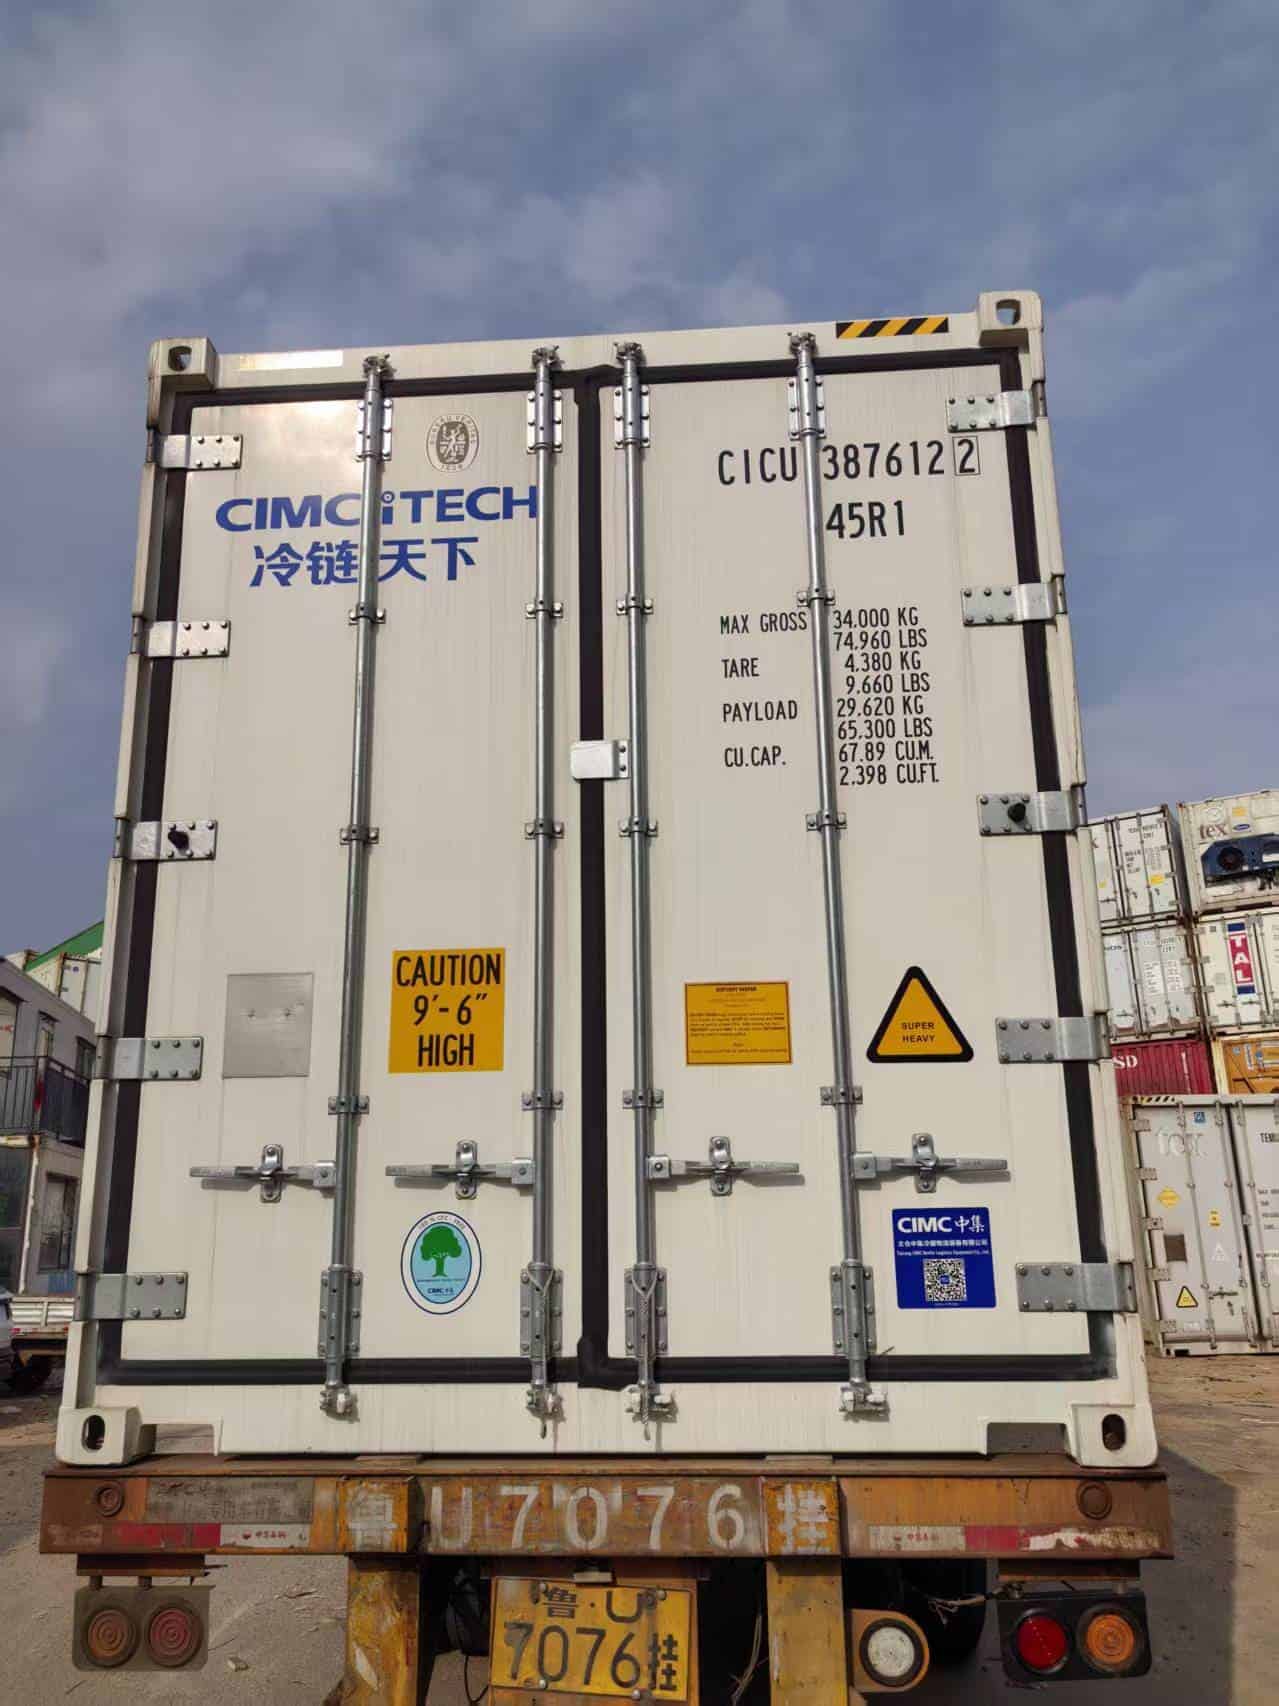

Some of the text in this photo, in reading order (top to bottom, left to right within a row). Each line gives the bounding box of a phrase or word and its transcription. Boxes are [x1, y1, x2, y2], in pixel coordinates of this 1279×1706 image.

[718, 438, 976, 486] CICU 387612 2
[215, 492, 361, 532] CIMC
[825, 499, 905, 539] 45R1
[249, 536, 479, 588] 冷链天下
[720, 607, 919, 635] MAX GROSS 34.000 KG
[833, 629, 928, 651] 74.960 LBS
[721, 651, 921, 679] TARE 4.380 KG
[846, 672, 931, 695] 9.660 LBS
[723, 695, 924, 723] PAYLOAD 29.620 KG
[838, 718, 933, 740] 65.300 LBS
[724, 740, 934, 767] CU.CAP. 67.89 CU.M.
[839, 763, 940, 786] 2.398 CU.FT.
[396, 953, 502, 987] CAUTION
[1230, 934, 1251, 983] TAL
[902, 1021, 935, 1031] SUPER
[902, 1034, 936, 1043] HEAVY
[417, 1033, 475, 1068] HIGH
[897, 1216, 953, 1233] CIMC
